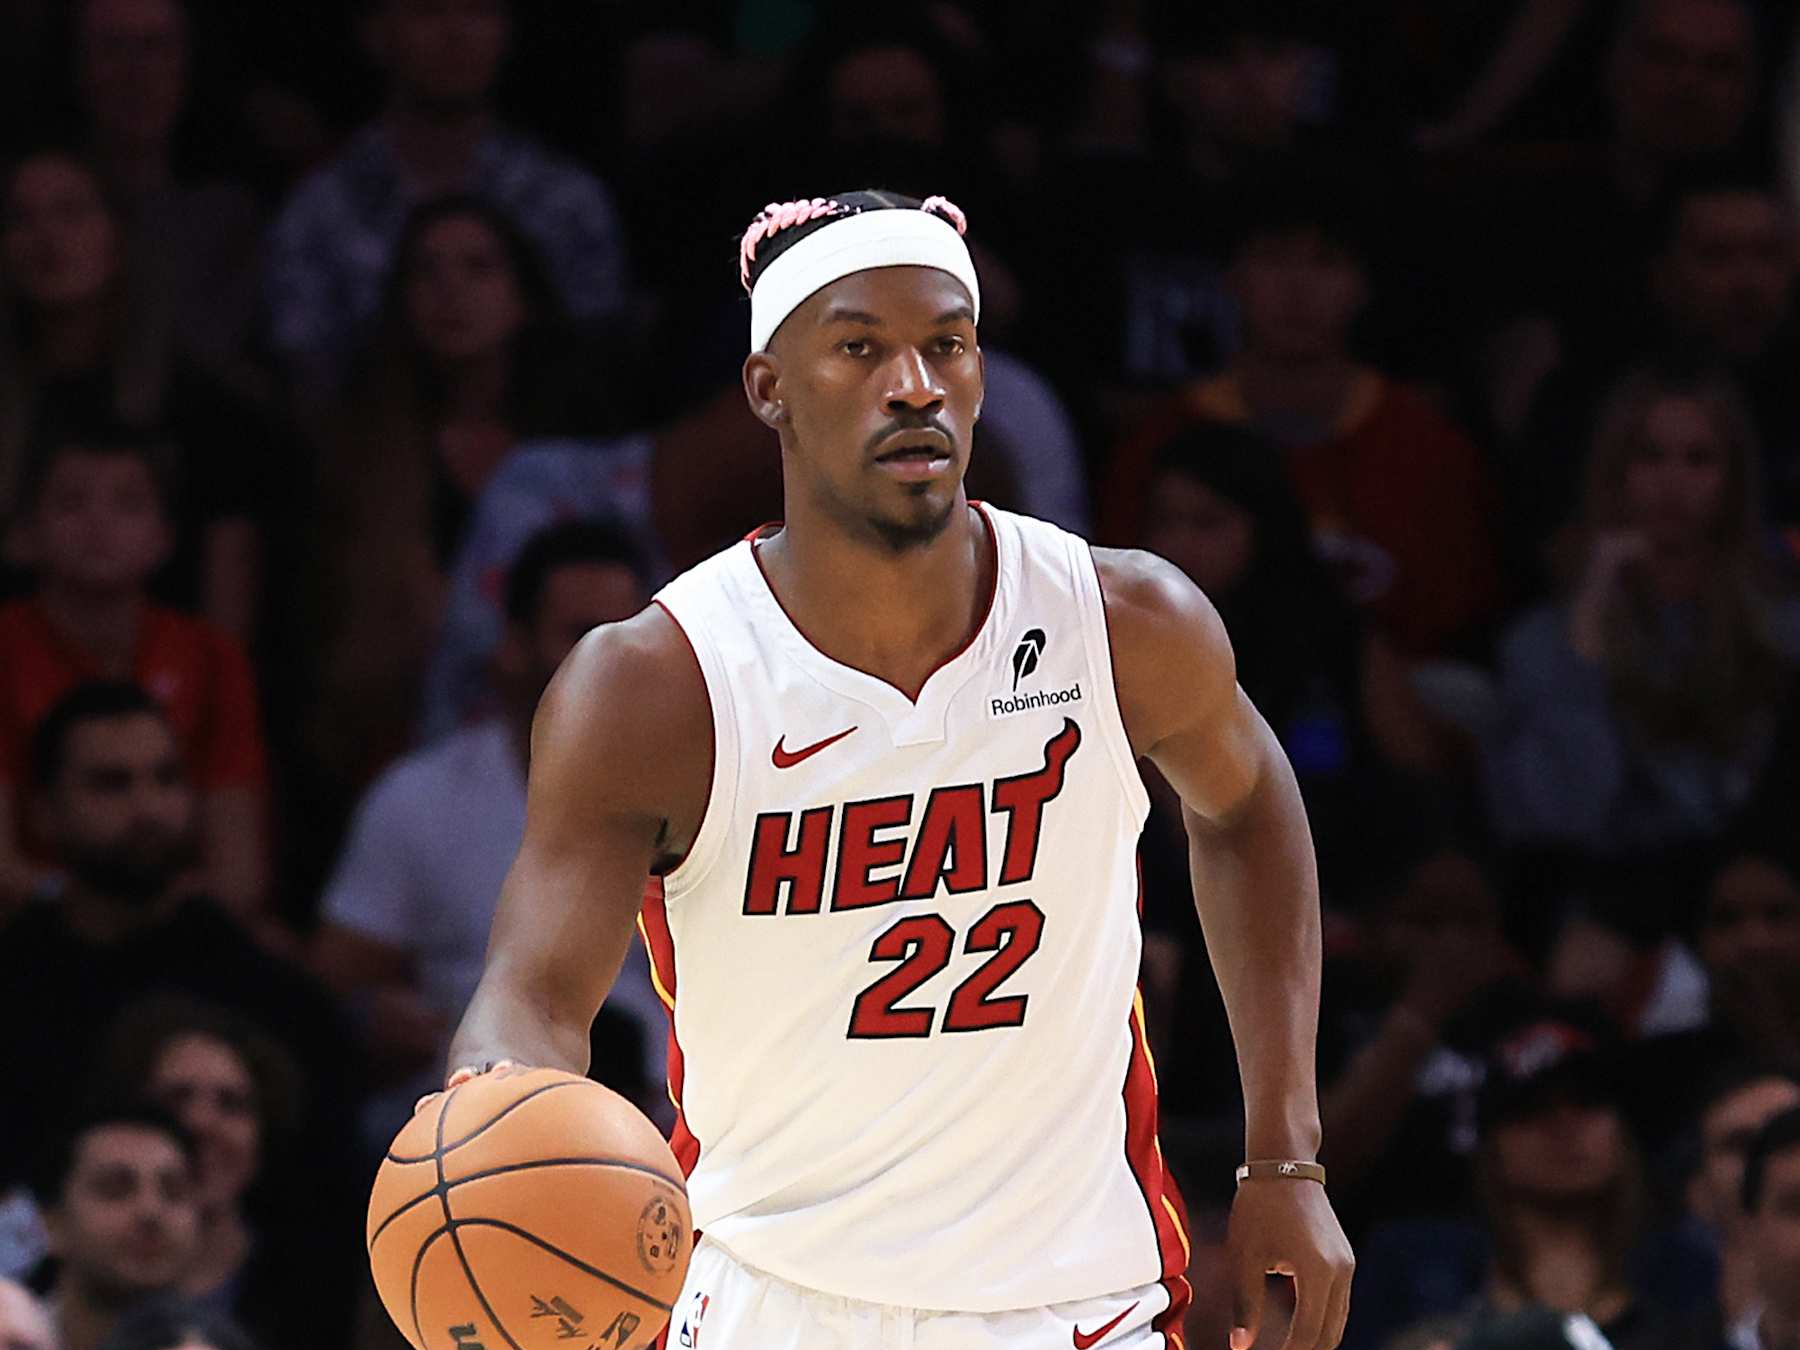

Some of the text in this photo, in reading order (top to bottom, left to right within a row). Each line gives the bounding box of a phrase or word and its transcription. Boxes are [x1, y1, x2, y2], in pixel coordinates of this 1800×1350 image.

[991, 683, 1082, 715] Robinhood
[742, 717, 1082, 916] HEAT
[846, 898, 1046, 1039] 22
